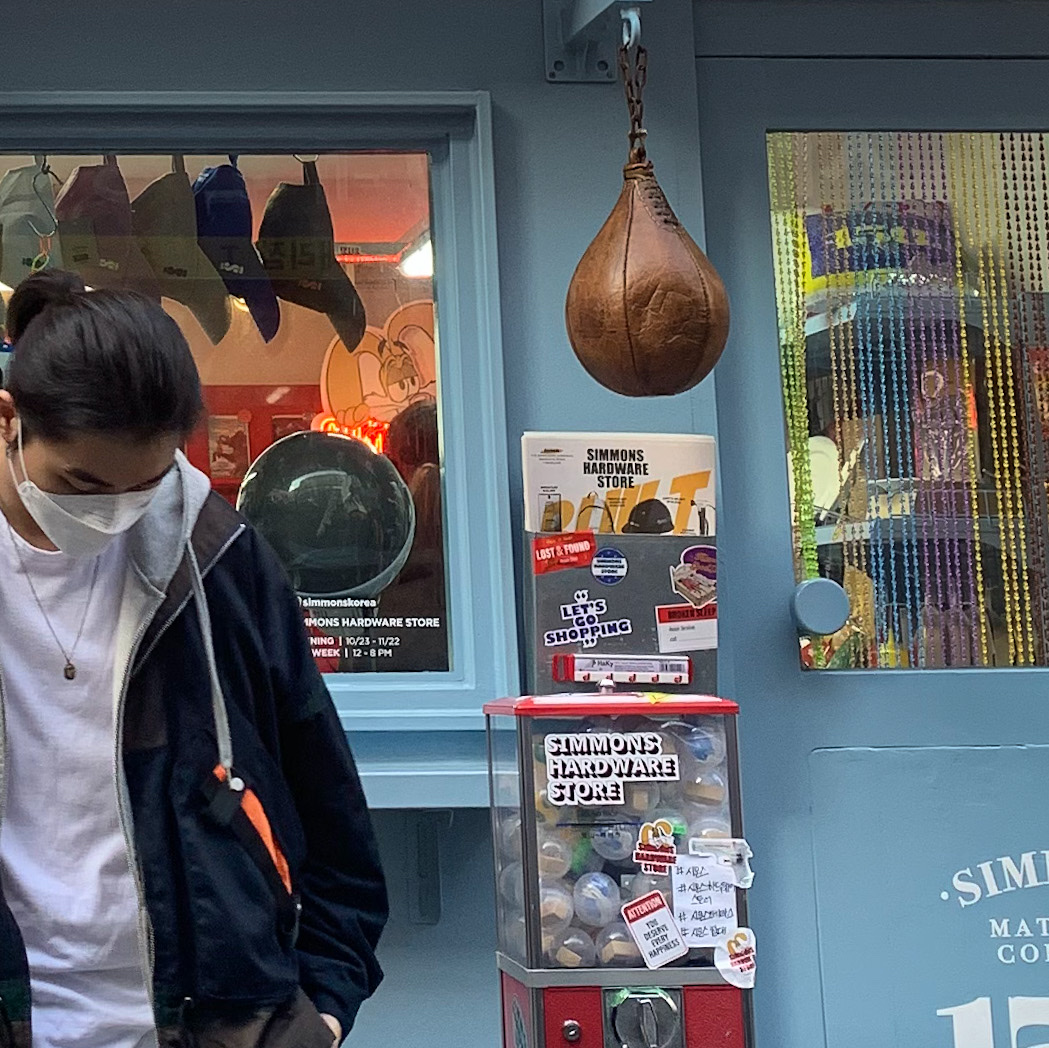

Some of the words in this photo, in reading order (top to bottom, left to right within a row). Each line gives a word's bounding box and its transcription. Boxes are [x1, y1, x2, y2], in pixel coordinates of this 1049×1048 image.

[586, 448, 644, 461] SIMMONS
[583, 462, 649, 475] HARDWARE
[597, 475, 634, 488] STORE
[536, 547, 555, 560] LOST
[556, 545, 564, 556] &
[563, 540, 591, 555] FOUND
[298, 597, 376, 607] simmonskorea
[562, 601, 604, 618] LET'S
[668, 609, 694, 619] BROKEN
[342, 617, 403, 627] HARDWARE
[405, 617, 440, 627] STORE
[575, 615, 597, 627] GO
[546, 621, 629, 644] SHOPPING
[346, 637, 370, 645] 10/23
[378, 637, 400, 645] 11/22
[312, 648, 340, 657] WEEK
[353, 649, 362, 657] 12
[370, 649, 376, 657] 8
[378, 649, 392, 657] PM
[547, 734, 662, 755] SIMMONS
[548, 758, 677, 780] HARDWARE
[549, 781, 623, 801] STORE
[627, 896, 663, 918] ATTENTION
[646, 919, 659, 929] YOU
[644, 924, 669, 940] DESERVE
[651, 934, 669, 948] EVERY
[648, 938, 680, 959] HAPPINESS
